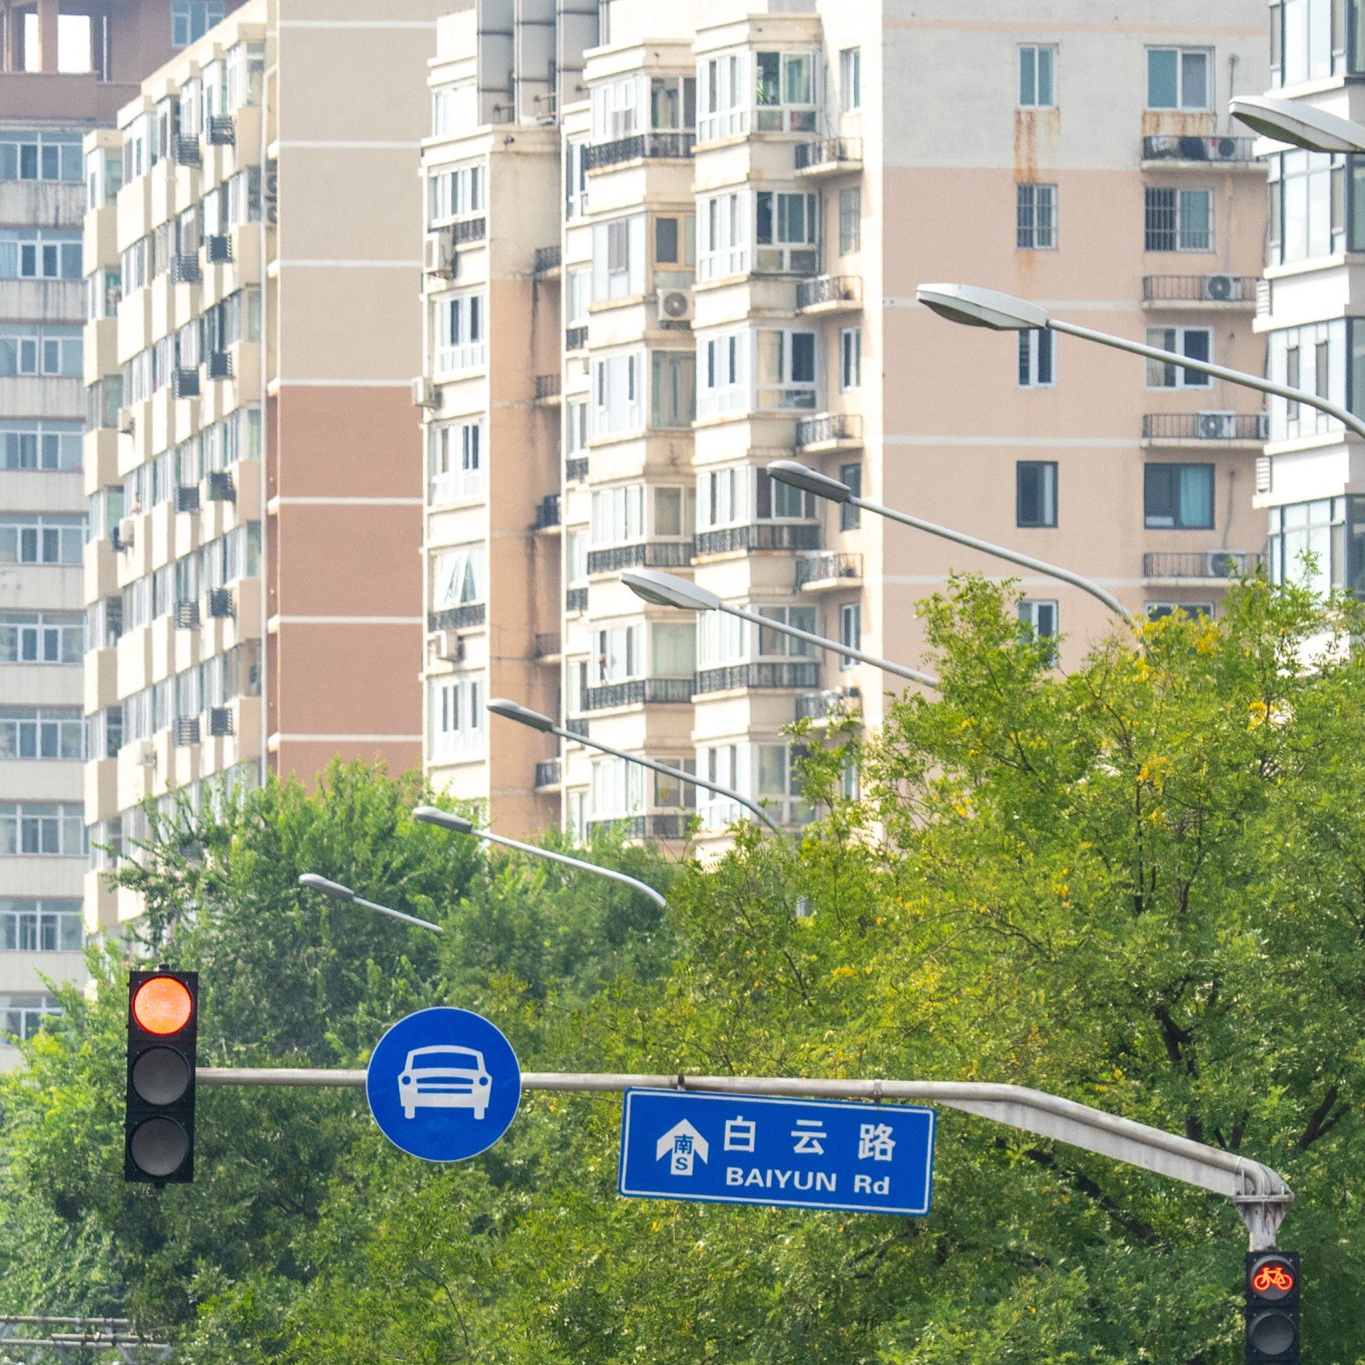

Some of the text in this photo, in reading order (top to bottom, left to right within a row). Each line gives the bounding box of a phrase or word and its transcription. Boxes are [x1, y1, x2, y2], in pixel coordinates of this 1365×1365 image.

[674, 1133, 695, 1156] 南
[723, 1115, 896, 1162] 白云路
[675, 1157, 689, 1171] S
[726, 1167, 890, 1195] BAIYUN Rd
